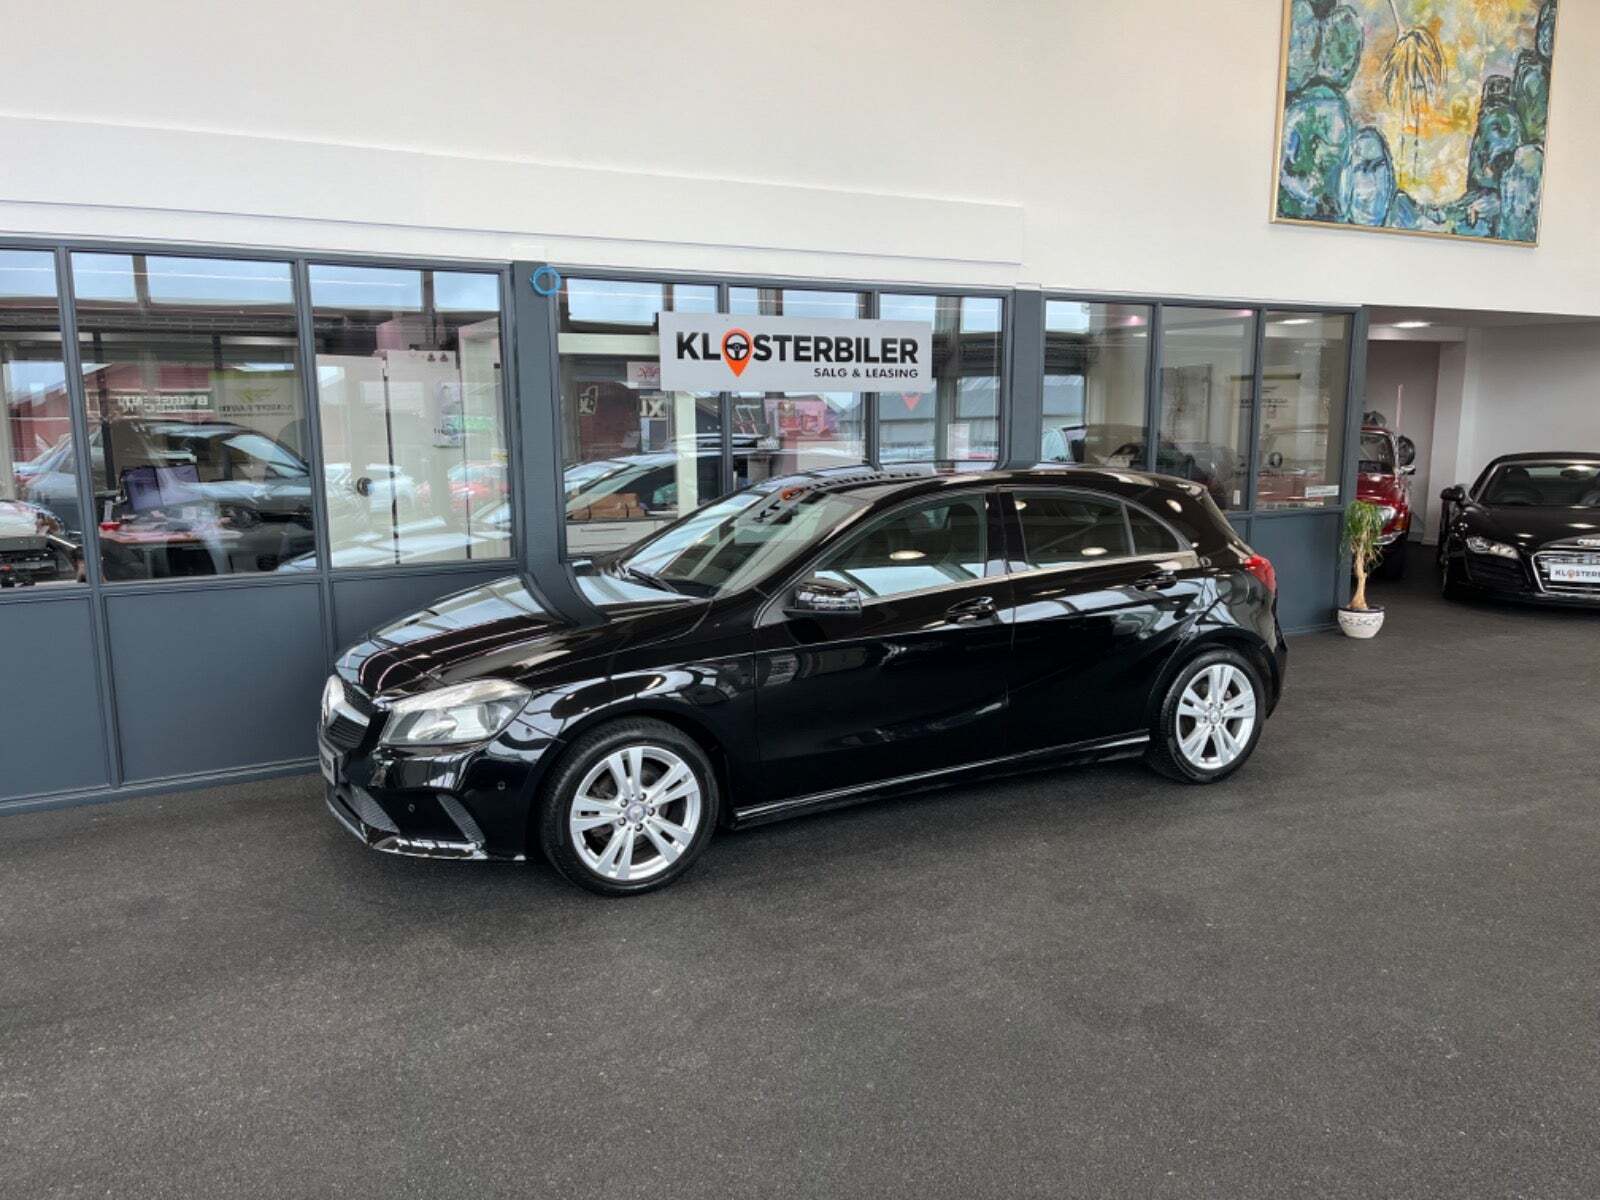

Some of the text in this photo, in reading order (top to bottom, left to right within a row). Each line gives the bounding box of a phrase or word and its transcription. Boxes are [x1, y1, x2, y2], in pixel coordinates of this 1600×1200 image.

[676, 330, 918, 367] KLOSTERBILER
[814, 367, 919, 379] SALG & LEASING
